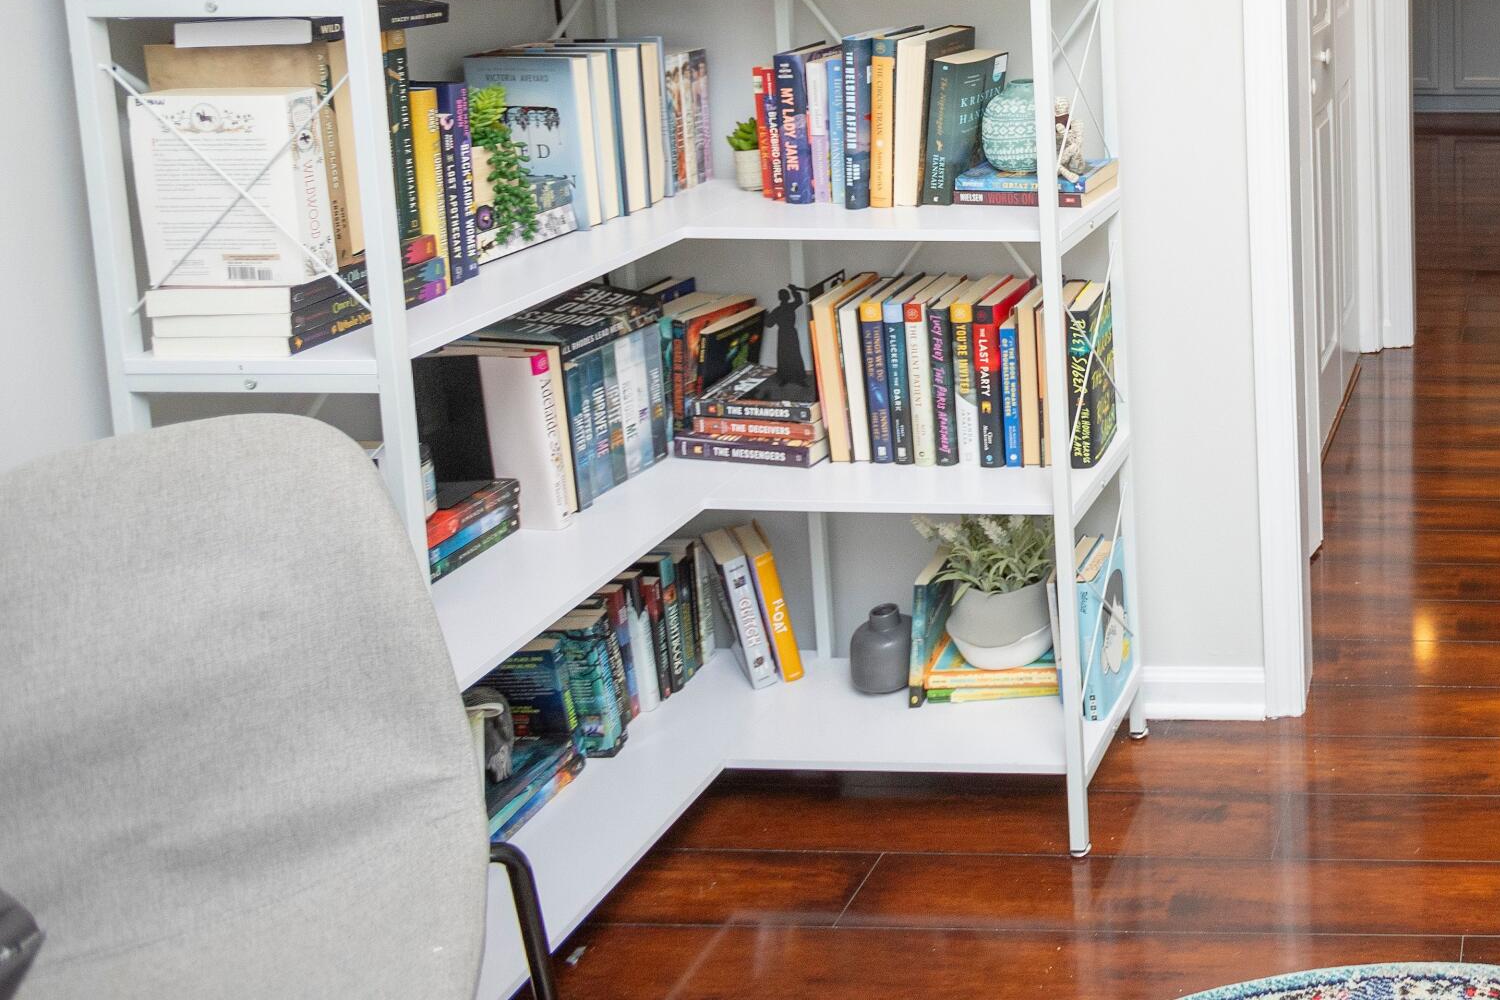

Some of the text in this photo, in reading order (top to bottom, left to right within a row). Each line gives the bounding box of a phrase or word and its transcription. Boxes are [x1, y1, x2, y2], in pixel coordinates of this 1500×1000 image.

[320, 23, 341, 34] WILD
[845, 67, 856, 113] HELSINKI
[768, 111, 781, 158] BLACKBIRD
[780, 87, 799, 171] MY LADY JANE
[846, 115, 857, 149] AFFAIR
[446, 164, 457, 190] LOST
[773, 159, 783, 184] GIRLS
[930, 154, 939, 189] HANNAH
[937, 156, 945, 189] KRISTIN
[302, 158, 321, 240] WILDWOOD
[460, 143, 476, 257] BLACK CANDLE WOMEN
[960, 193, 983, 202] NIELSEN
[449, 195, 462, 259] APOTHECARY
[929, 315, 943, 335] LUCY
[889, 335, 898, 369] FLICKER
[910, 343, 919, 370] SILENT
[931, 335, 944, 361] FOLEY
[956, 324, 970, 394] YOU'RE INVITED
[979, 339, 988, 363] LAST
[1069, 318, 1088, 394] RILEY SAGER
[913, 374, 922, 407] PATIENT
[935, 384, 948, 411] PARIS
[980, 366, 991, 397] PARTY
[540, 378, 561, 438] Adelaide
[591, 385, 609, 437] UNRAVEL
[727, 406, 790, 418] THE STRANGERS
[893, 388, 901, 412] DARK
[730, 423, 791, 436] THE DECEIVERS
[936, 411, 951, 455] APARTMENT
[713, 446, 786, 462] THE MESSENGERS
[738, 597, 761, 648] GLITCH
[772, 598, 788, 634] FLOAT
